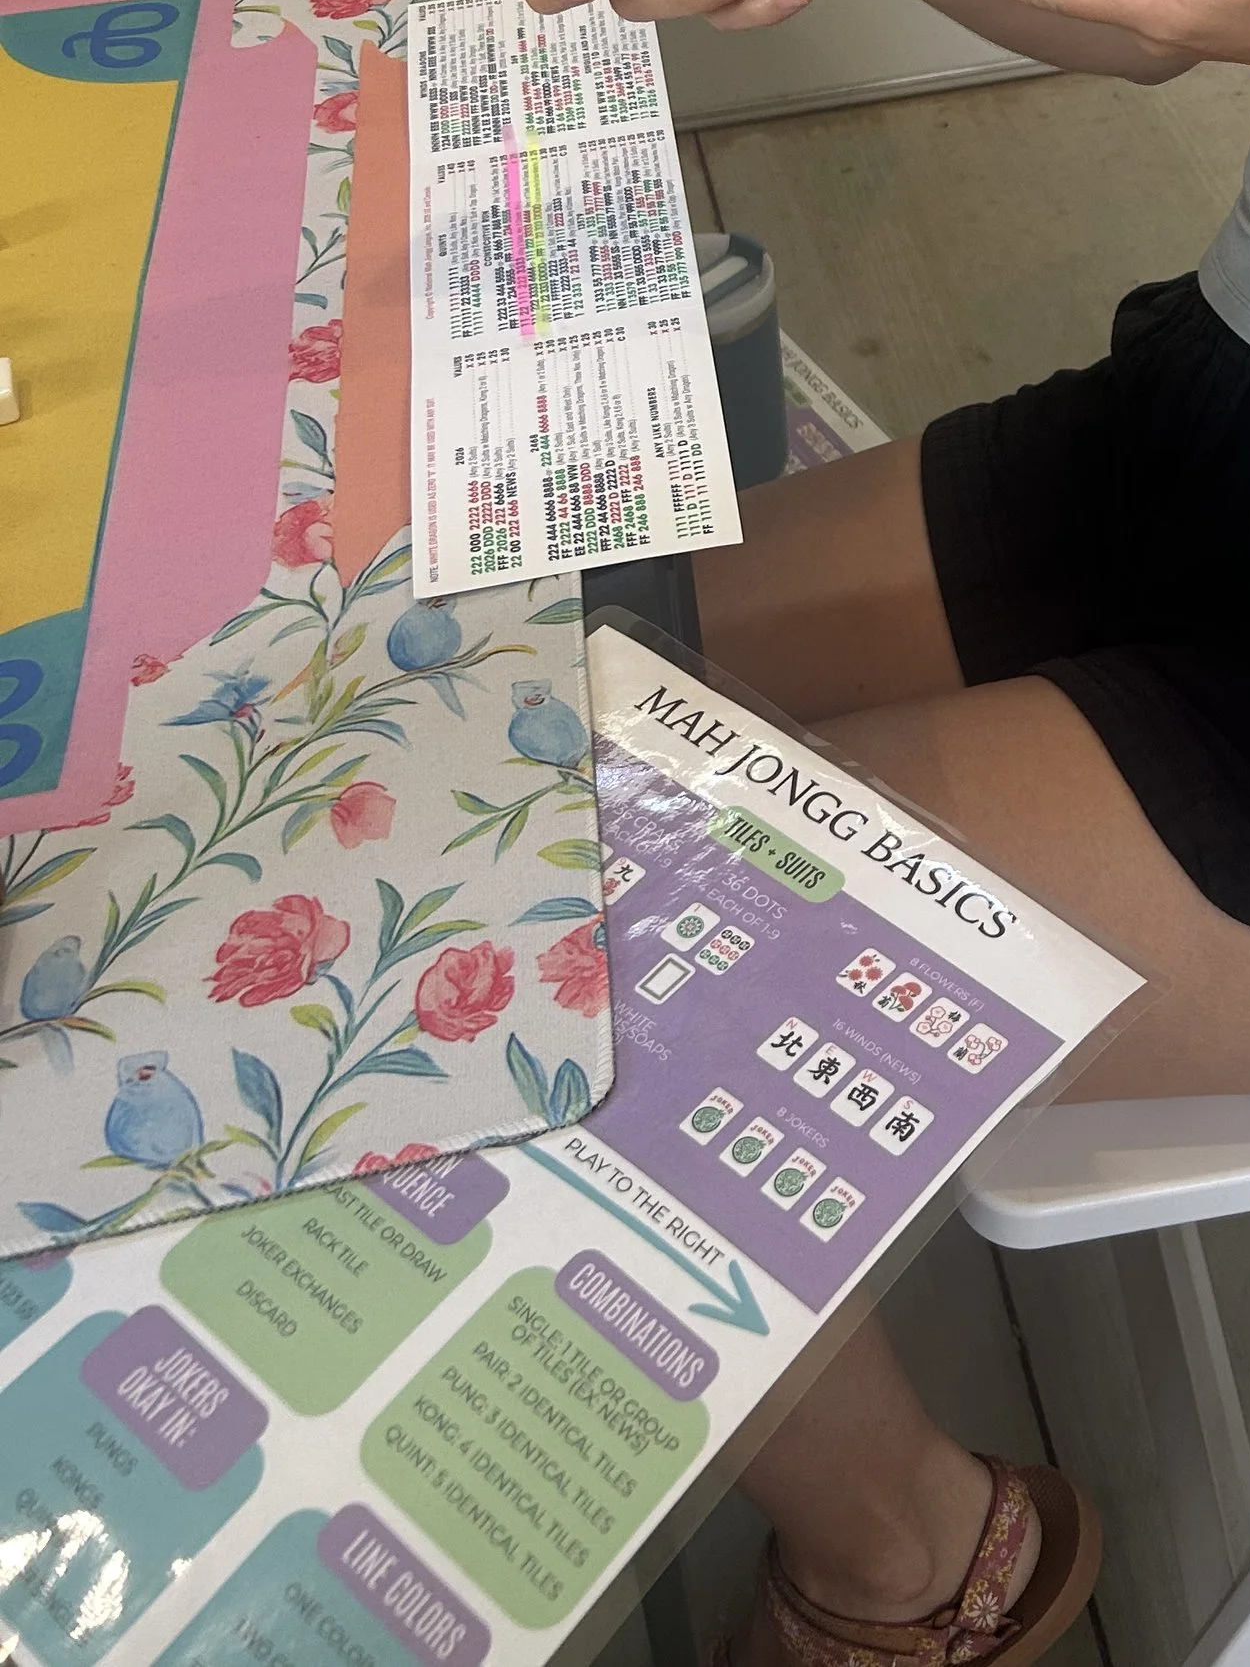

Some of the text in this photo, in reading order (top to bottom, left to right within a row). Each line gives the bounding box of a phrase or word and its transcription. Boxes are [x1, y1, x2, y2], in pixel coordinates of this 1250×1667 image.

[642, 51, 651, 67] 2026
[645, 69, 654, 87] 2026
[501, 98, 510, 115] 2026
[648, 89, 657, 107] 2026
[530, 434, 539, 452] 2468
[647, 387, 665, 458] ANY LIKE NUMBERS
[455, 448, 465, 465] 2026
[468, 480, 482, 575] 222 000 2222 6666
[481, 481, 496, 572] 2026 DDD 2222 DDD
[494, 483, 509, 570] FFF 2026 222 6666
[506, 472, 522, 568] 22 00 222 666 NEWS
[555, 468, 573, 558] FF 2222 44 66 8888
[619, 464, 638, 547] FFF 2468 FFF 2222
[630, 455, 651, 544] FF 246 888 246 888
[634, 685, 1017, 939] MAH JONGG BASICS
[724, 816, 771, 854] TILES
[775, 850, 826, 890] SUITS
[706, 889, 781, 940] EACH OF 1-9
[722, 871, 788, 920] 36 DOTS
[918, 963, 971, 1004] FLOWERS
[770, 1031, 804, 1057] 北
[786, 1019, 799, 1030] N
[824, 1045, 836, 1056] E
[832, 1019, 921, 1085] 16 WINDS (NEWS)
[807, 1056, 840, 1086] 東
[848, 1082, 879, 1112] 西
[862, 1069, 877, 1083] W
[710, 1094, 736, 1115] JOKER
[785, 1112, 831, 1150] JOKERS
[885, 1111, 921, 1143] 南
[903, 1098, 914, 1110] S
[749, 1124, 775, 1147] JOKER
[383, 1164, 455, 1218] QUENCE
[791, 1154, 817, 1179] JOKER
[830, 1185, 856, 1209] JOKER
[564, 1137, 726, 1266] PLAY TO THE RIGHT
[303, 1217, 370, 1278] RACK TILE
[354, 1202, 384, 1233] TILE
[379, 1225, 405, 1249] OR
[399, 1240, 448, 1283] DRAW
[236, 1279, 298, 1338] DISCARD
[240, 1224, 364, 1335] JOKER EXCHANGES
[569, 1262, 705, 1388] COMBINATIONS
[116, 1365, 198, 1448] OKAY IN:
[154, 1347, 230, 1420] JOKERS
[511, 1324, 535, 1346] OF
[532, 1341, 576, 1386] TILES
[597, 1401, 651, 1457] NEWS)
[567, 1347, 602, 1384] TILE
[600, 1378, 627, 1407] OR
[623, 1399, 681, 1453] GROUP
[507, 1372, 524, 1392] 2
[518, 1384, 592, 1462] IDENTICAL
[593, 1450, 640, 1499] TILES
[458, 1438, 473, 1456] 4
[469, 1446, 544, 1532] IDENTICAL
[545, 1519, 591, 1569] TILES
[496, 1417, 570, 1499] IDENTICAL
[572, 1487, 617, 1535] TILES
[442, 1480, 517, 1564] IDENTICAL
[519, 1551, 564, 1603] TILES
[340, 1529, 467, 1662] LINE COLORS
